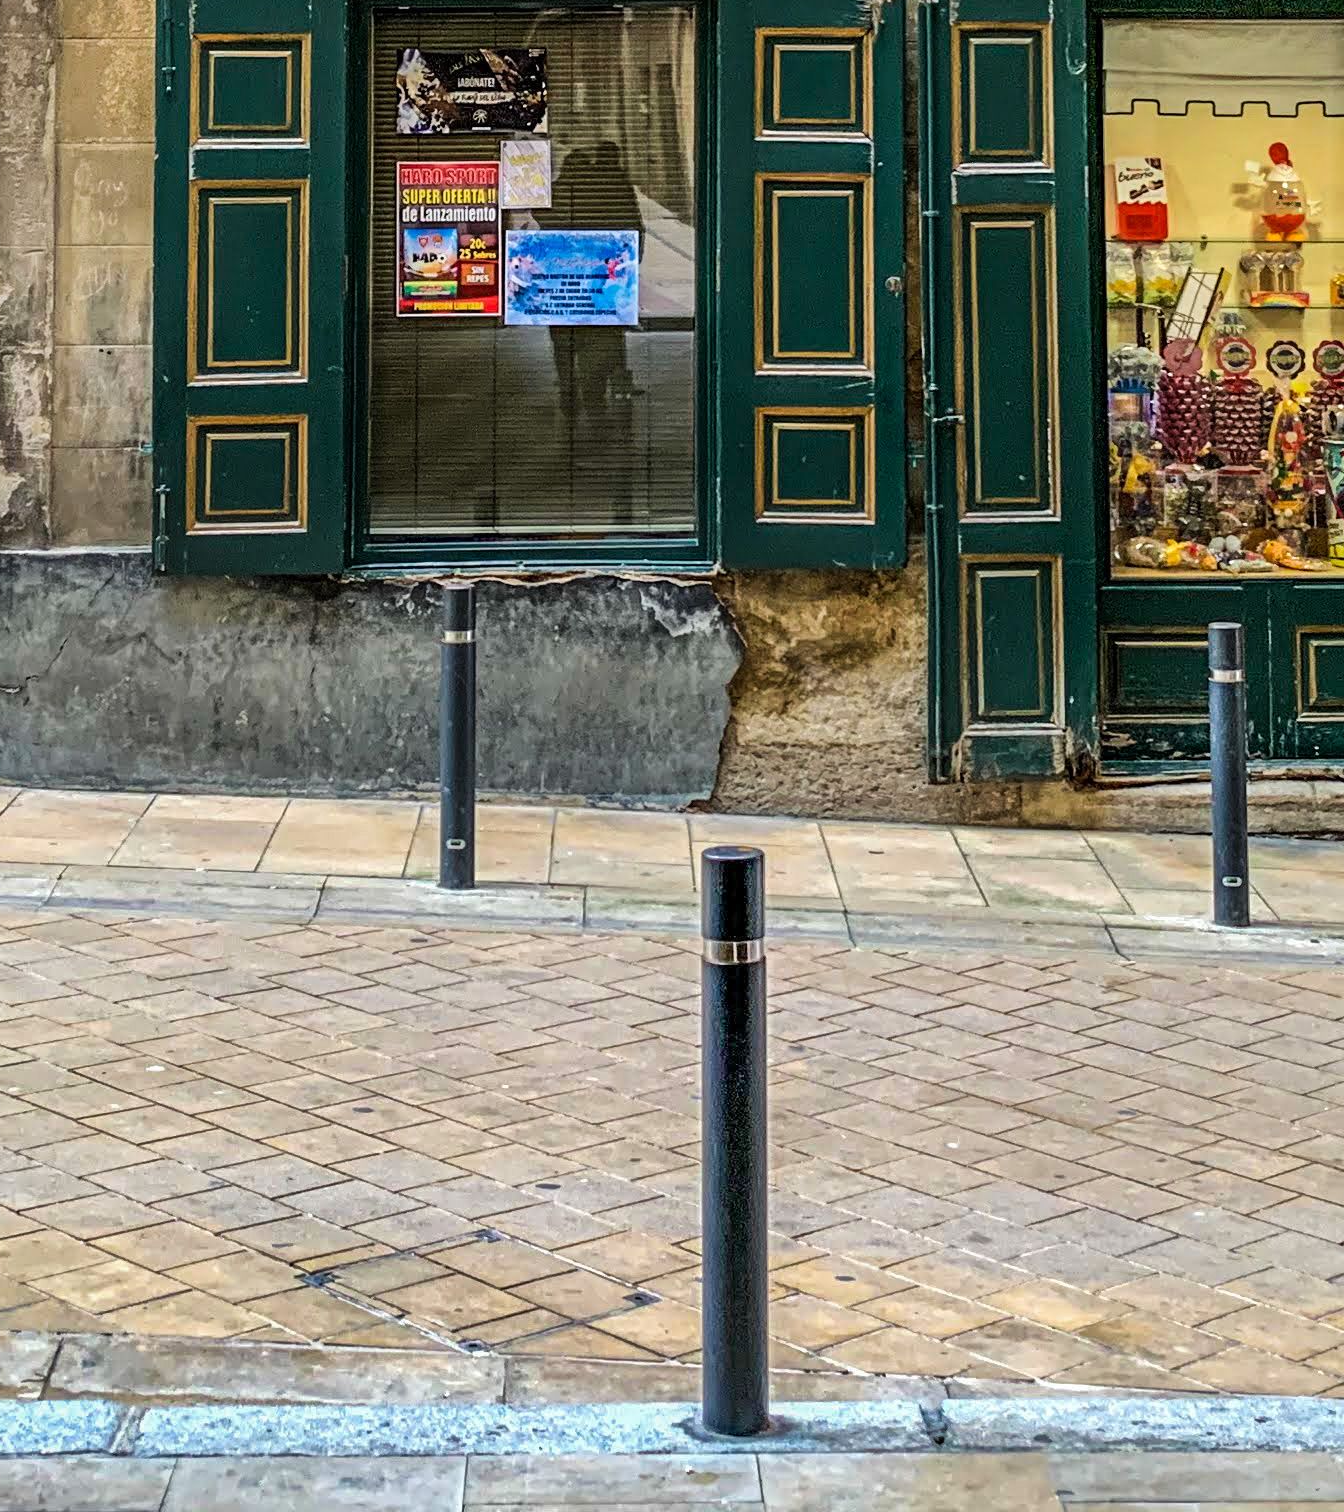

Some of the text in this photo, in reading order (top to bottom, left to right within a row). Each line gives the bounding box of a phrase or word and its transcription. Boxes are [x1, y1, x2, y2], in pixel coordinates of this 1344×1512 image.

[401, 168, 496, 185] HARO SPORT
[402, 188, 496, 204] SUPER OFERTA !!
[402, 206, 496, 222] de Lanzamiento
[459, 248, 471, 259] 25
